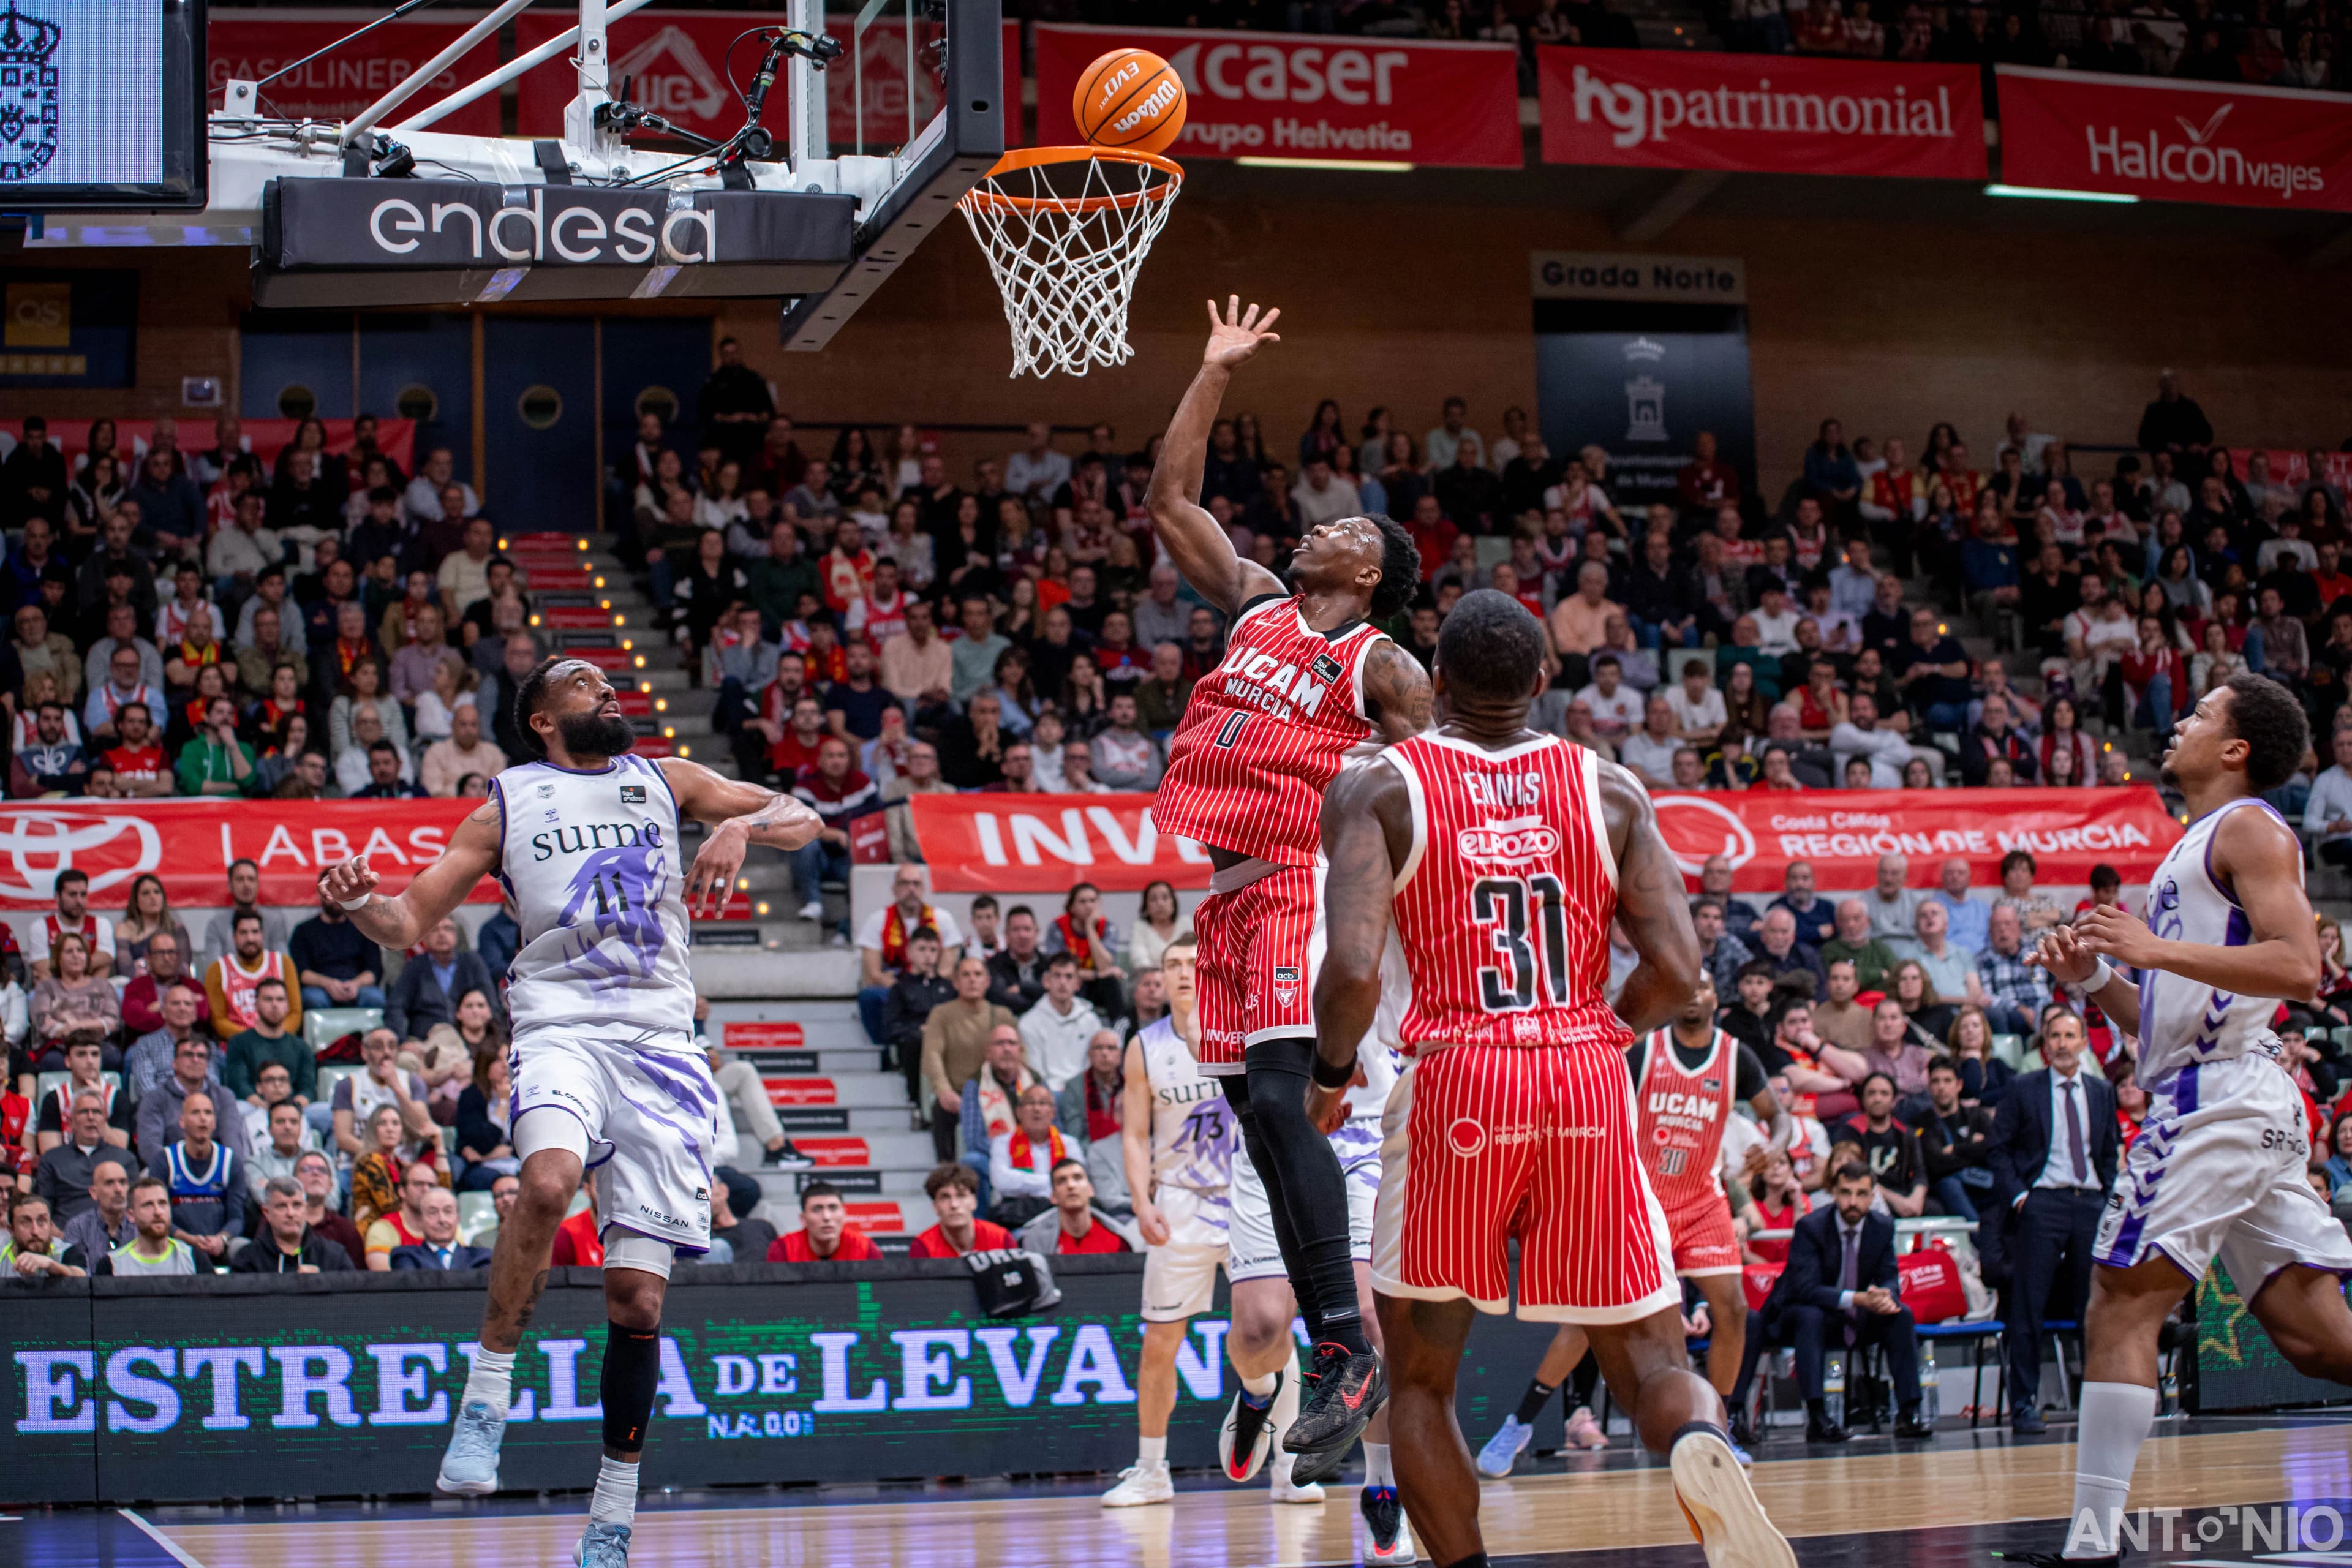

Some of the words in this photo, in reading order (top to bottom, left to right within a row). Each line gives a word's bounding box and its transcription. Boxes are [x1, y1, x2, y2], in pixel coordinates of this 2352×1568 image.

[209, 58, 457, 89] GASOLINERS
[1205, 45, 1408, 105] caser
[1113, 80, 1177, 133] Wilson
[1175, 121, 1264, 152] rupo
[1273, 119, 1411, 151] Helvetia
[2247, 163, 2324, 198] viajes
[370, 189, 716, 263] endesa
[1542, 262, 1640, 287] Grada
[1655, 265, 1735, 292] Norte
[1313, 664, 1335, 682] endesa
[1316, 658, 1328, 669] liga
[1221, 646, 1327, 719] UCAM
[1223, 677, 1292, 723] MURCIA
[1215, 710, 1251, 749] 0
[1462, 771, 1542, 807] ENNIS
[1770, 813, 1828, 831] Costa
[1779, 828, 1933, 858] REGIÓN
[1937, 829, 1992, 853] DE
[1996, 823, 2150, 854] MURCIA
[589, 871, 630, 915] 11
[1471, 871, 1572, 1013] 31
[1205, 1029, 1245, 1044] INVER
[1648, 1092, 1719, 1123] UCAM
[1187, 1110, 1224, 1142] 73
[640, 1204, 690, 1229] NISSAN
[711, 1353, 798, 1395] DE
[810, 1318, 1308, 1412] LEVAN
